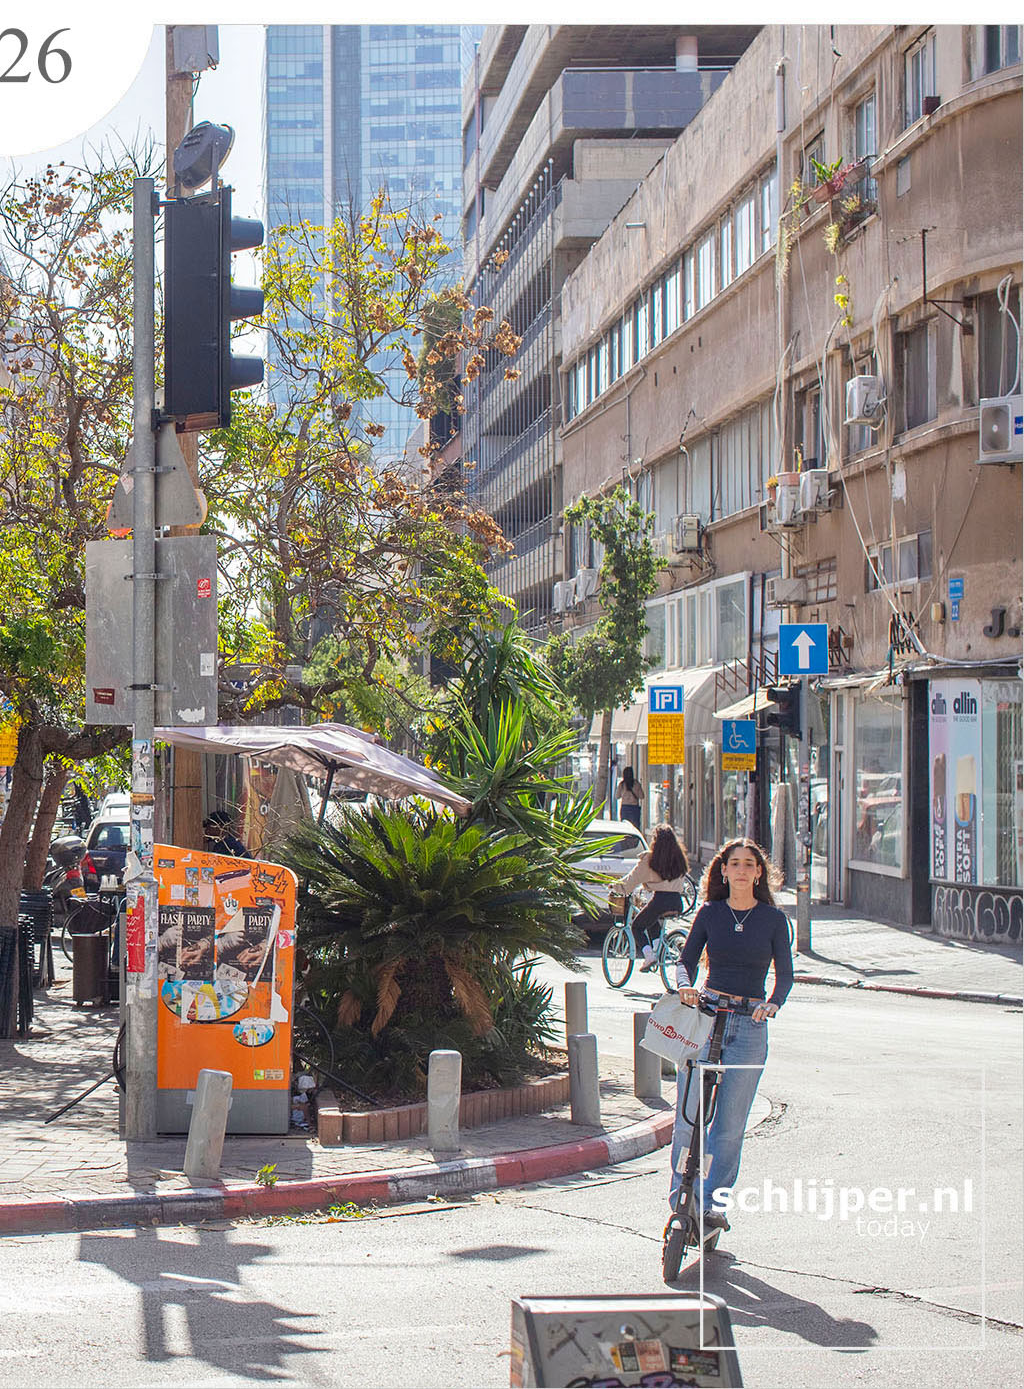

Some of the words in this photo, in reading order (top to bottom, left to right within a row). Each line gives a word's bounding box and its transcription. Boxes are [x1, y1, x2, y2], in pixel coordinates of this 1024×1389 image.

[953, 691, 977, 714] allin
[963, 829, 971, 883] SOFT
[161, 913, 185, 925] FLASH
[187, 914, 212, 926] PARTY
[248, 914, 272, 927] PARTY
[677, 1034, 699, 1050] Pharm
